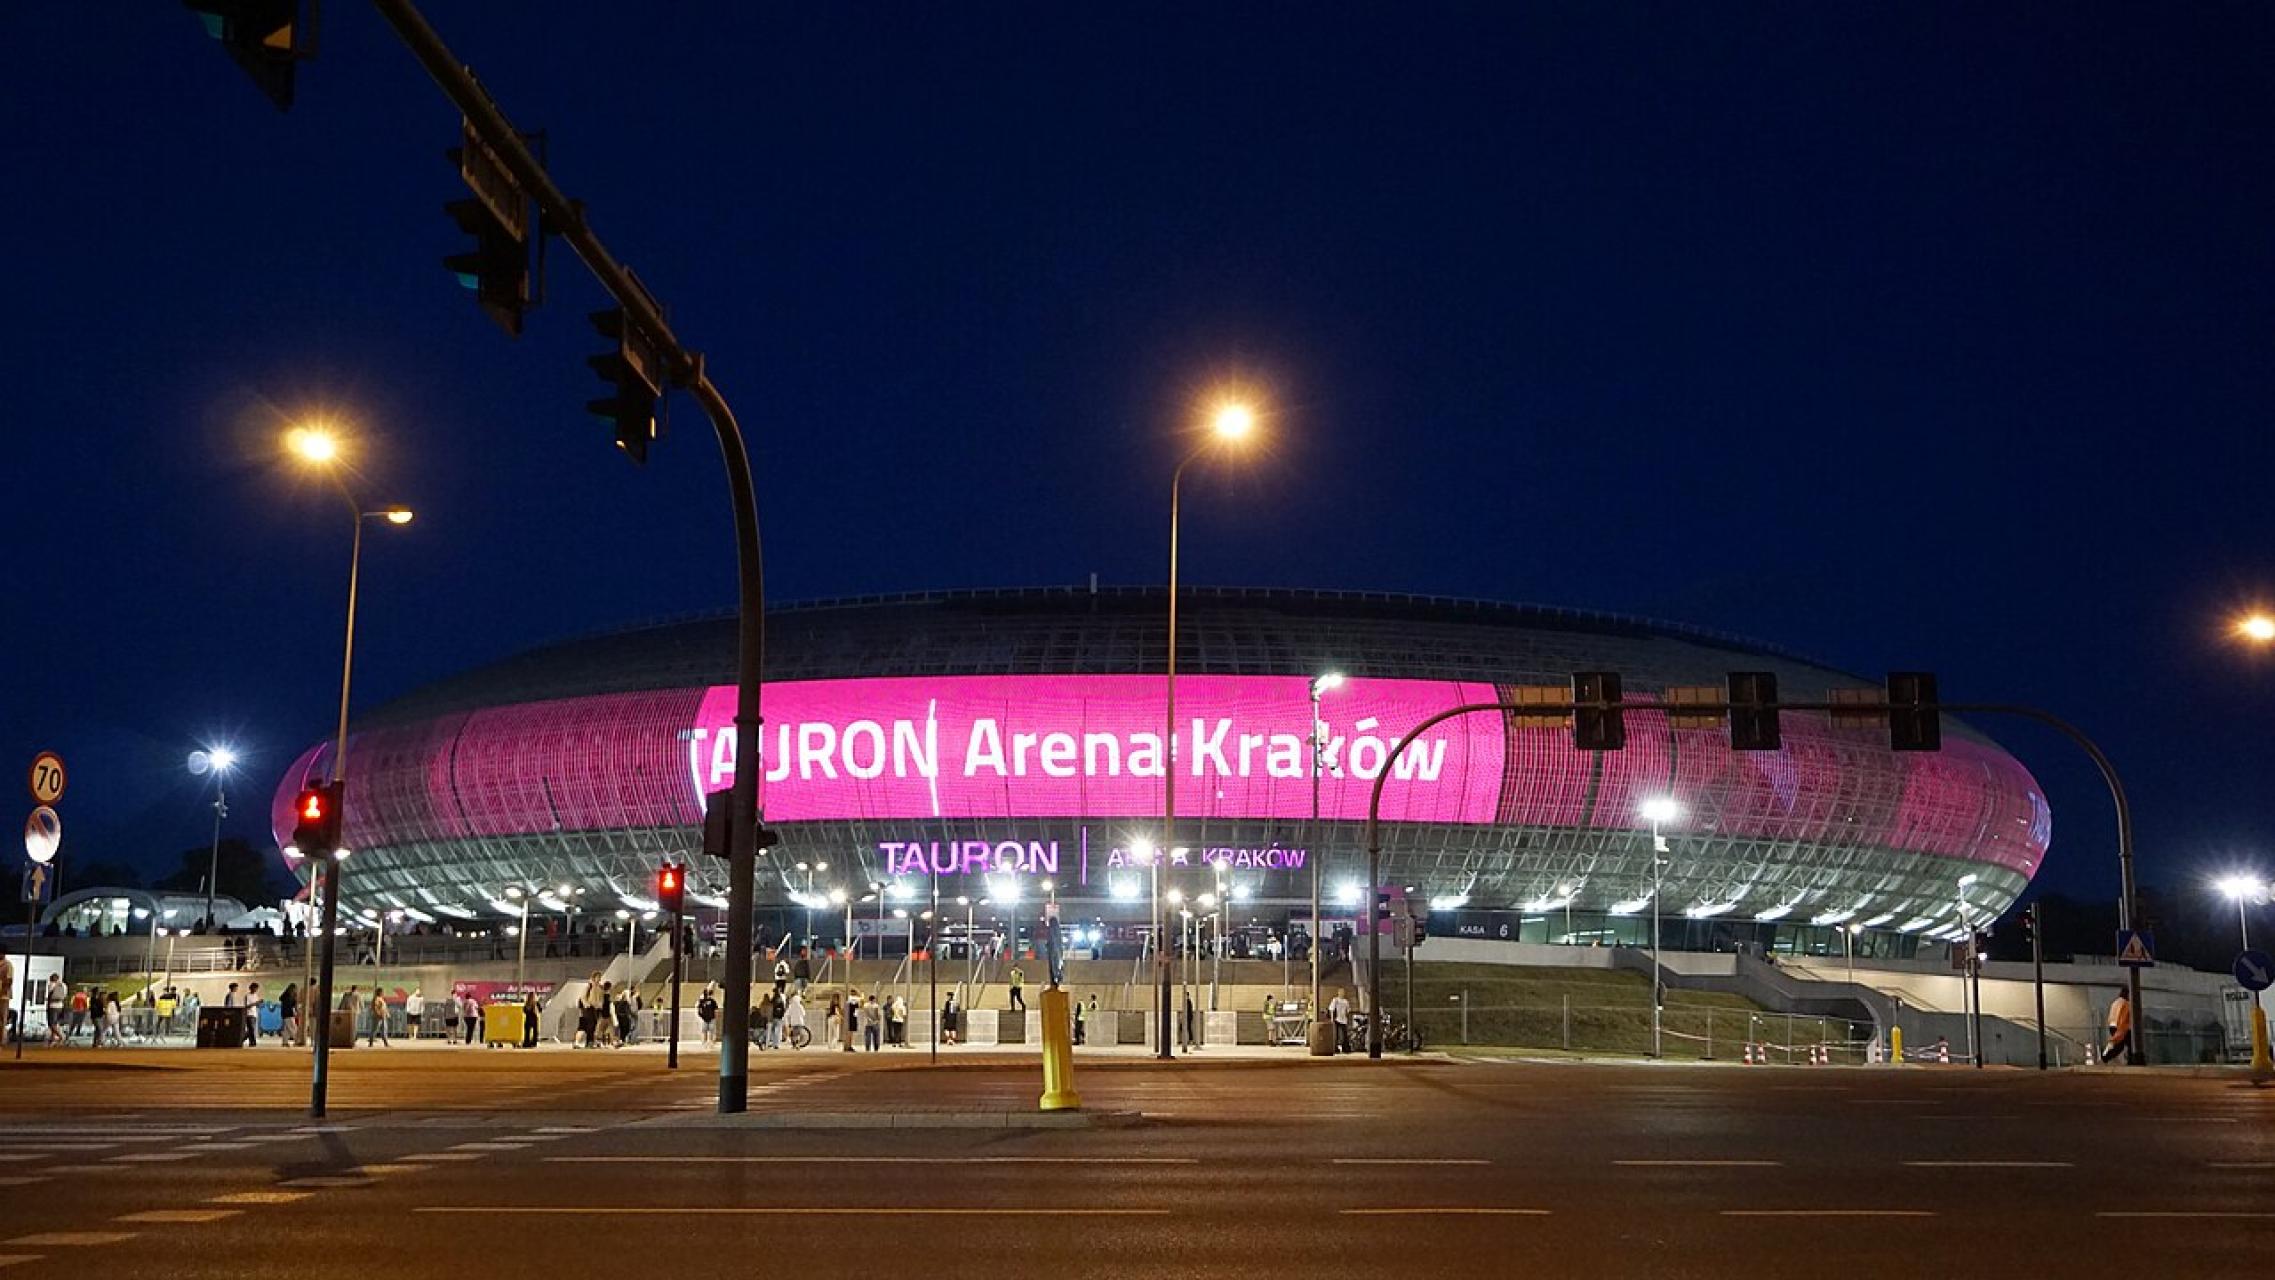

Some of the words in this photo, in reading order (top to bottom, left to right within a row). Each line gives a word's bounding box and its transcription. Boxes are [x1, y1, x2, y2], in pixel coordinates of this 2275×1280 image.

[963, 719, 1167, 777] Arena
[37, 766, 61, 793] 70
[879, 841, 1058, 874] TAURON
[1202, 842, 1305, 869] KRAKÓW
